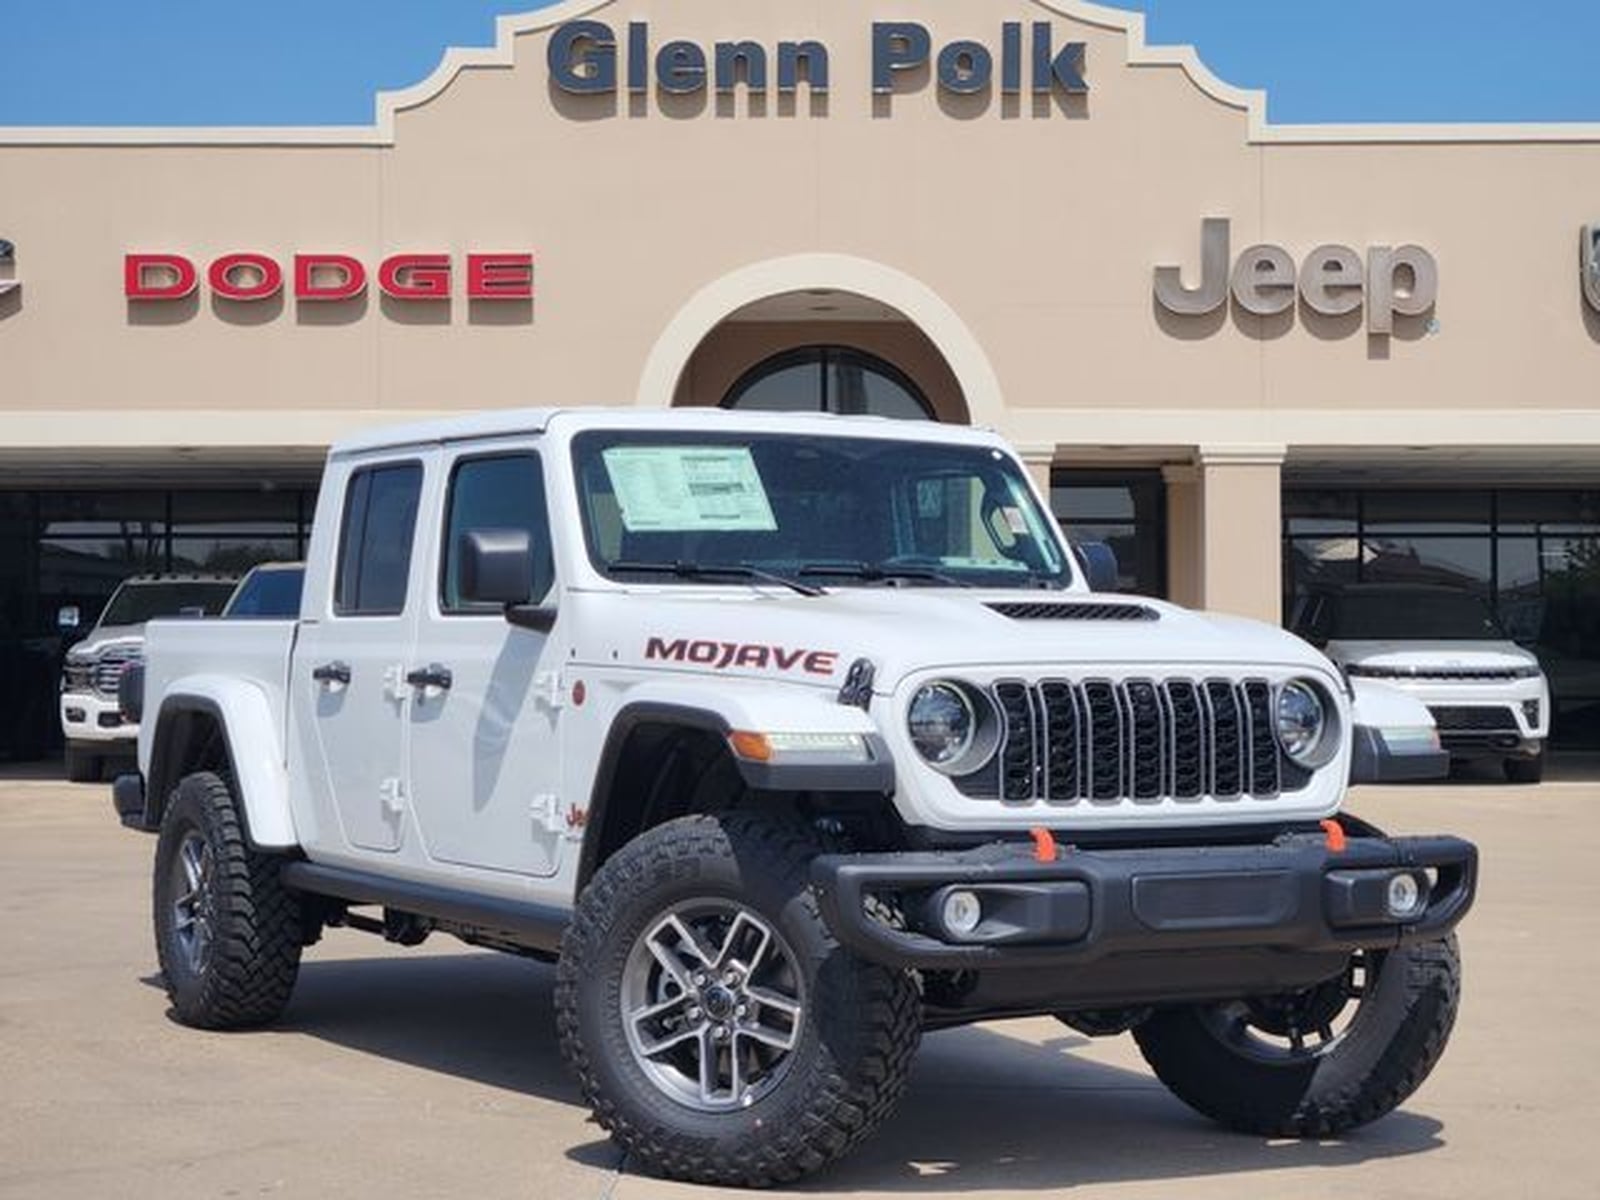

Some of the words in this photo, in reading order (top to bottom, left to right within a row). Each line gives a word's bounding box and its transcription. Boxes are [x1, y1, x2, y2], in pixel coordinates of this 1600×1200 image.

[547, 20, 828, 94] Glenn
[872, 21, 1089, 95] Polk
[124, 253, 534, 300] DODGE
[1153, 217, 1438, 334] Jeep
[645, 637, 839, 675] MOJAVE
